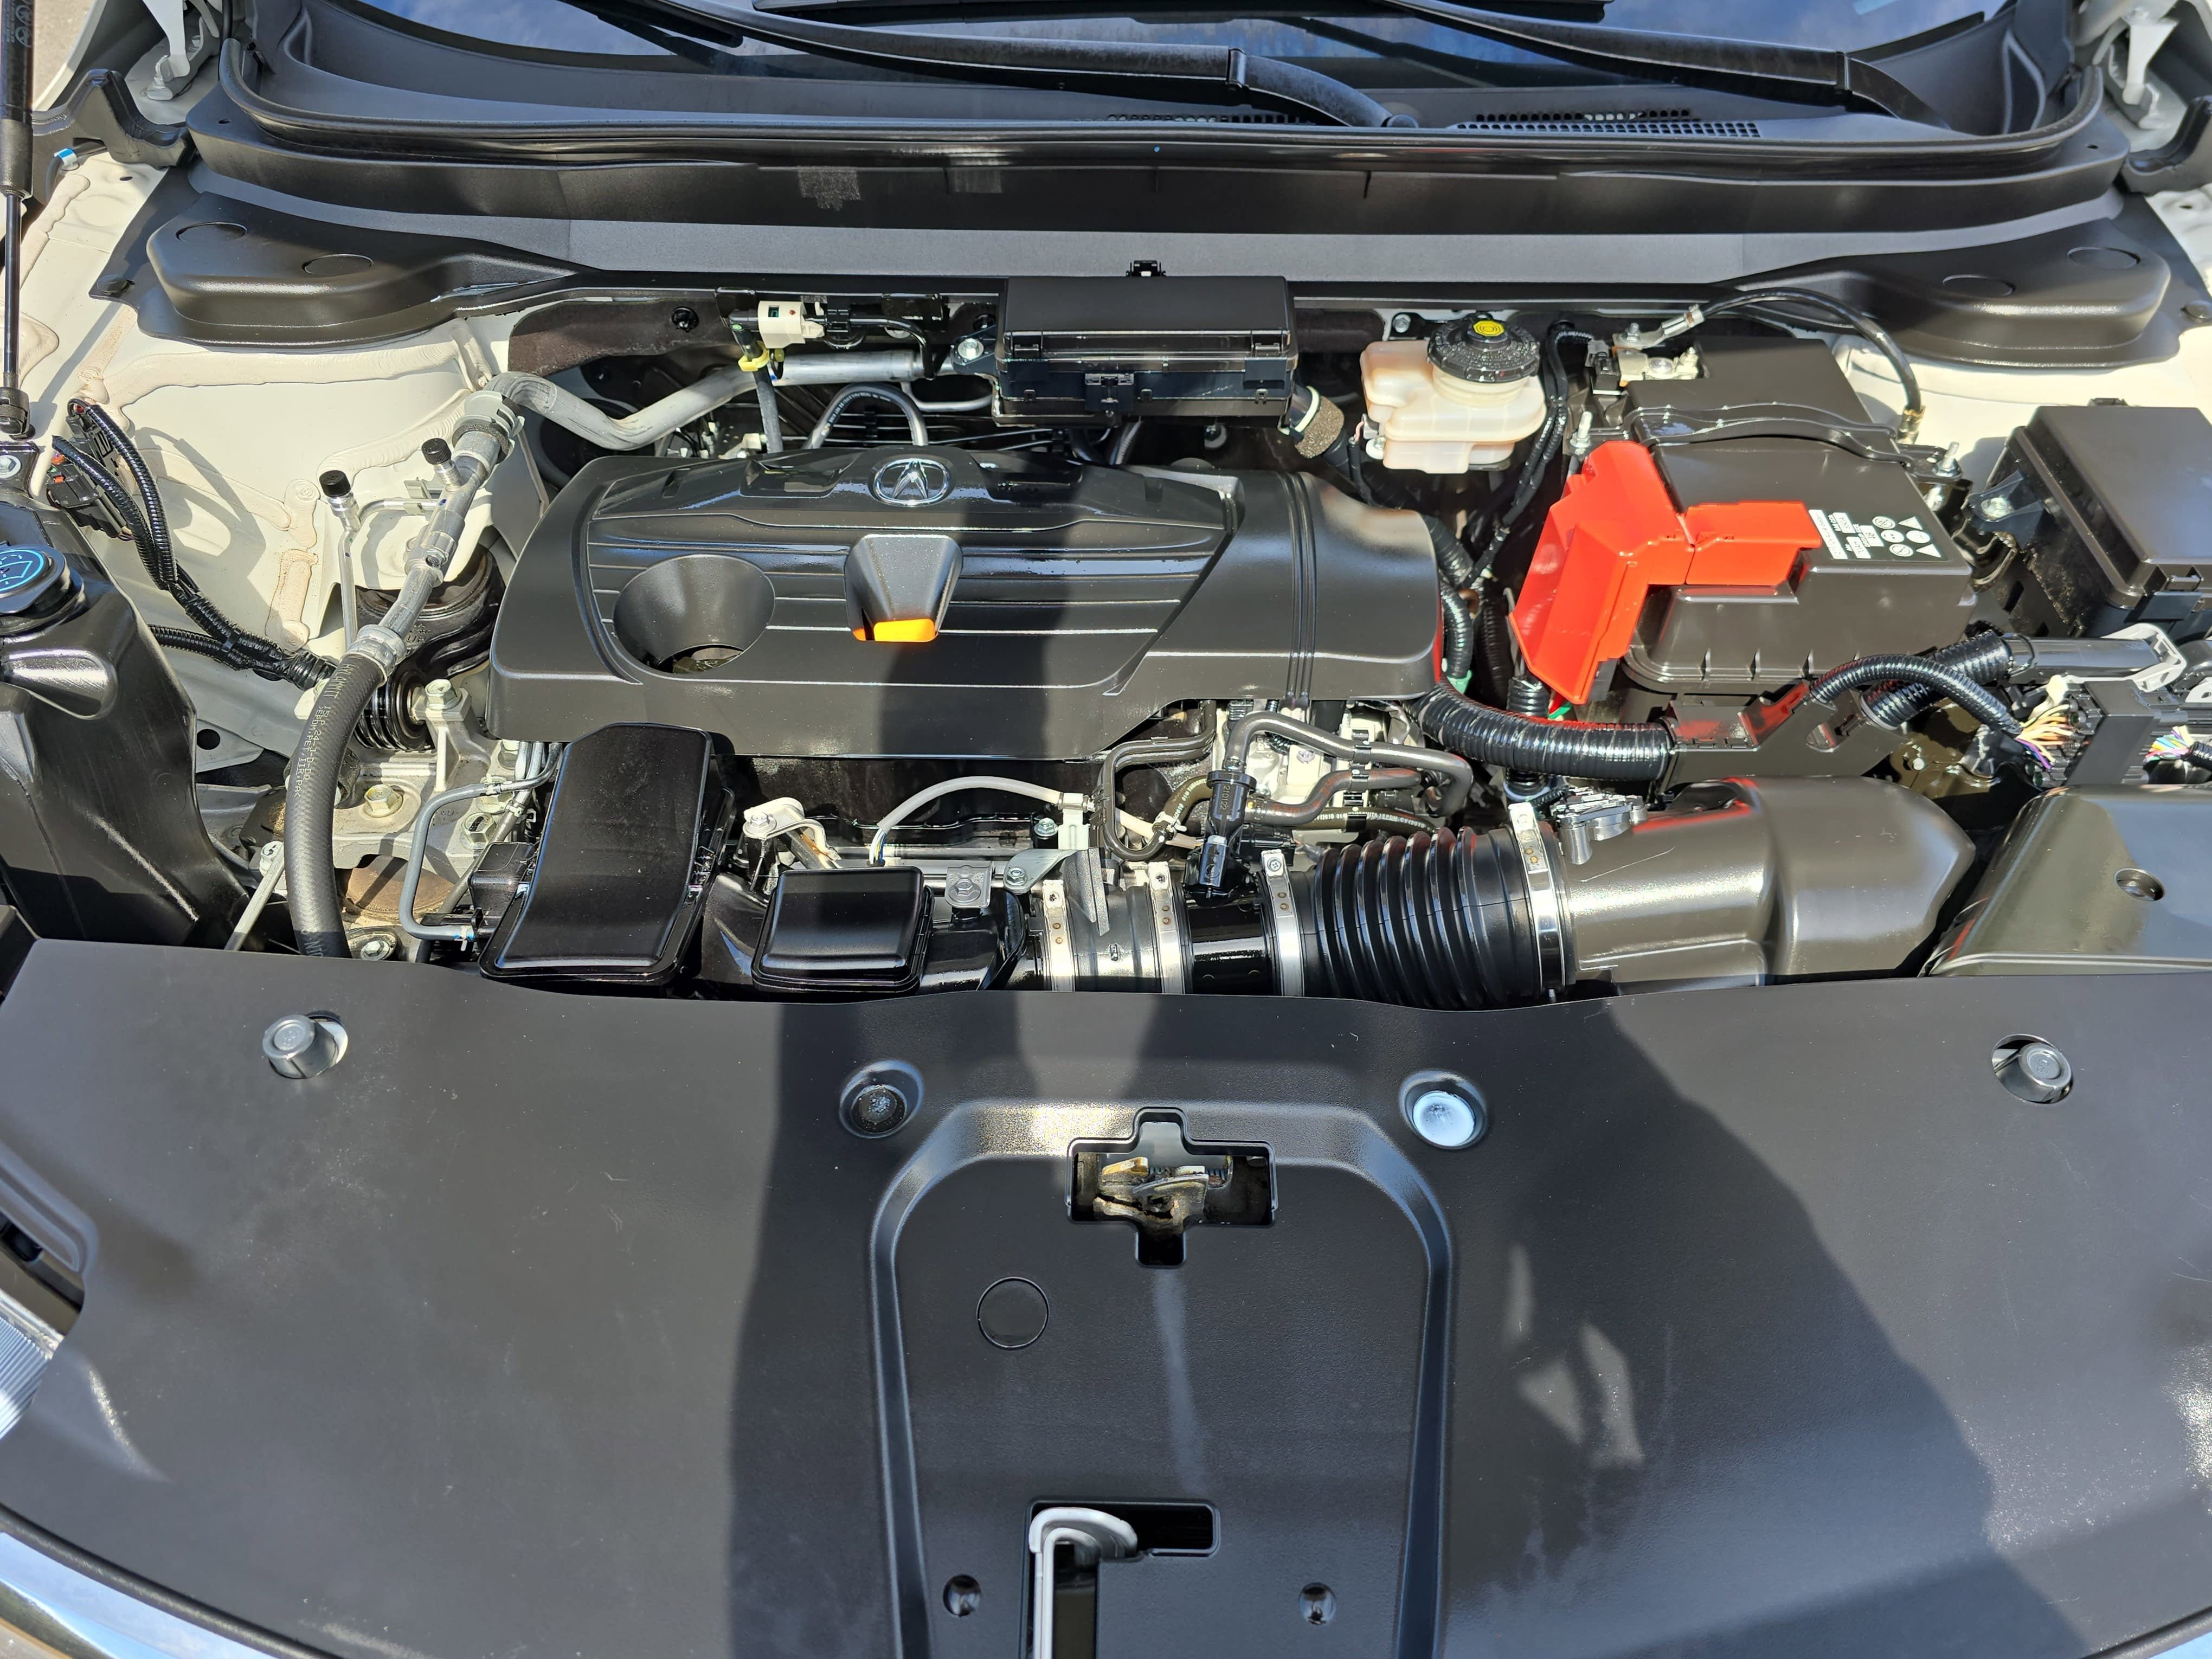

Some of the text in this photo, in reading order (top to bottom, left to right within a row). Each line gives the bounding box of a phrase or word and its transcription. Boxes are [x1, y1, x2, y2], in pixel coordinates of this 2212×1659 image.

[318, 706, 331, 725] 15LP
[1187, 778, 1207, 792] YAMASHIT
[1220, 785, 1231, 810] 210122
